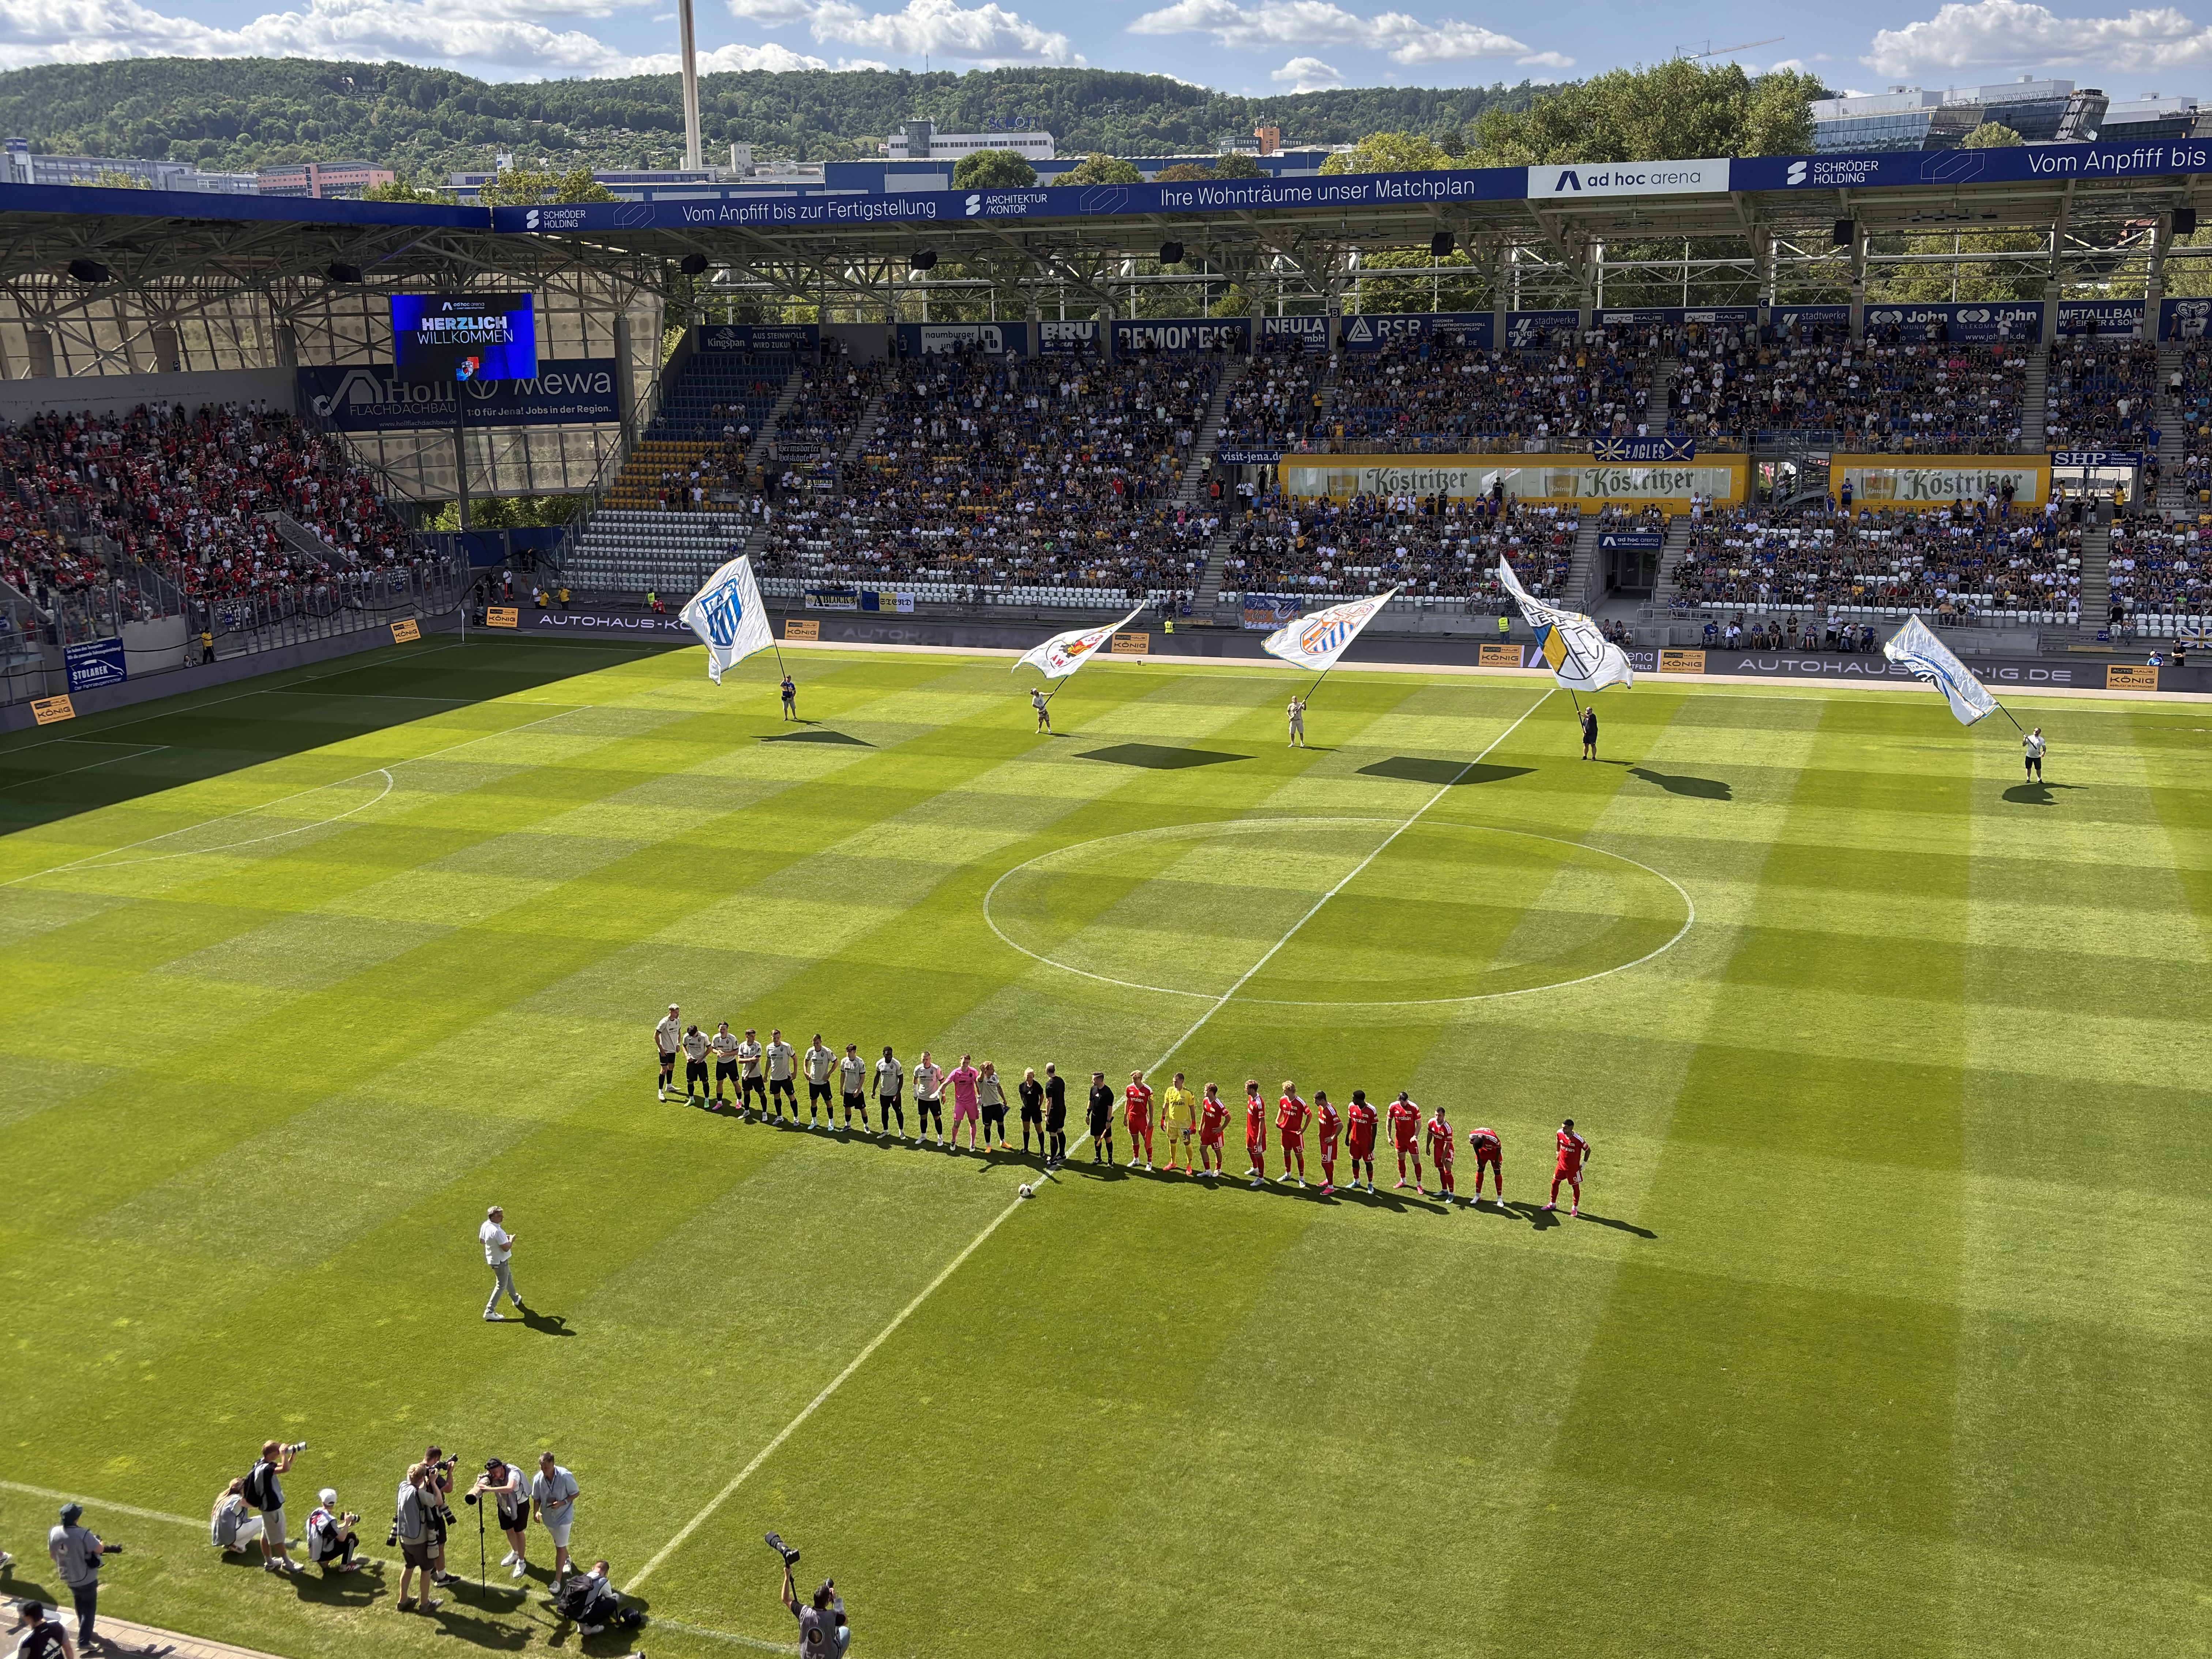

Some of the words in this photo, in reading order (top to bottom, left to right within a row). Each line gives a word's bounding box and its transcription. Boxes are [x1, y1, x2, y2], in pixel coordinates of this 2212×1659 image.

[2028, 153, 2076, 173] Vom
[2084, 147, 2163, 174] Anpfiff
[2172, 146, 2206, 166] bis
[1814, 160, 1878, 173] SCHRÖDER
[1588, 172, 1609, 186] ad
[1615, 172, 1645, 185] hoc
[1651, 172, 1700, 185] arena
[1814, 173, 1865, 183] HOLDING
[1162, 189, 1192, 206] Ihre
[1198, 185, 1312, 205] Wohnträume
[1318, 184, 1369, 200] unser
[1376, 177, 1475, 200] Matchplan
[986, 194, 1047, 205] ARCHITEKTUR
[543, 210, 586, 219] SCHRÖDER
[682, 206, 715, 222] Vom
[720, 203, 769, 224] Anpfiff
[774, 203, 796, 219] bis
[801, 206, 824, 218] zur
[828, 199, 936, 221] Fertigstellung
[986, 204, 1027, 214] /KONTOR
[544, 219, 578, 229] HOLDING
[1332, 309, 1338, 317] B
[1802, 310, 1846, 320] stadtwerke
[1907, 311, 1948, 323] John
[1994, 309, 2036, 321] John
[2059, 308, 2143, 319] METALLBAU
[422, 316, 507, 331] HERZLICH
[1266, 318, 1325, 334] NEULA
[1534, 316, 1576, 325] stadtwerke
[1041, 323, 1092, 339] BRU
[1378, 319, 1421, 336] RSB
[417, 330, 513, 344] WILLKOMMEN
[926, 331, 974, 339] naumburger
[707, 338, 745, 349] Kingspan
[514, 372, 611, 395] Mewa
[384, 379, 456, 403] Holl
[350, 403, 456, 416] FLACHDACHBAU
[482, 407, 496, 416] für
[498, 406, 523, 415] Jena!
[526, 406, 548, 414] Jobs
[550, 406, 558, 414] in
[560, 405, 575, 413] der
[577, 404, 612, 415] Region.
[778, 445, 820, 453] Hermsdorfer
[1625, 444, 1665, 459] EAGLES
[778, 454, 809, 463] Holzköpfe
[1221, 451, 1283, 463] visit-jena.de
[2055, 452, 2106, 465] SHP
[1366, 468, 1468, 496] Köstritzer
[823, 595, 849, 604] BLOCK
[1251, 598, 1265, 609] Fan
[1252, 611, 1267, 620] Club
[395, 629, 418, 638] KÖNIG
[73, 665, 108, 680] STOLAREK
[38, 706, 71, 718] KÖNIG
